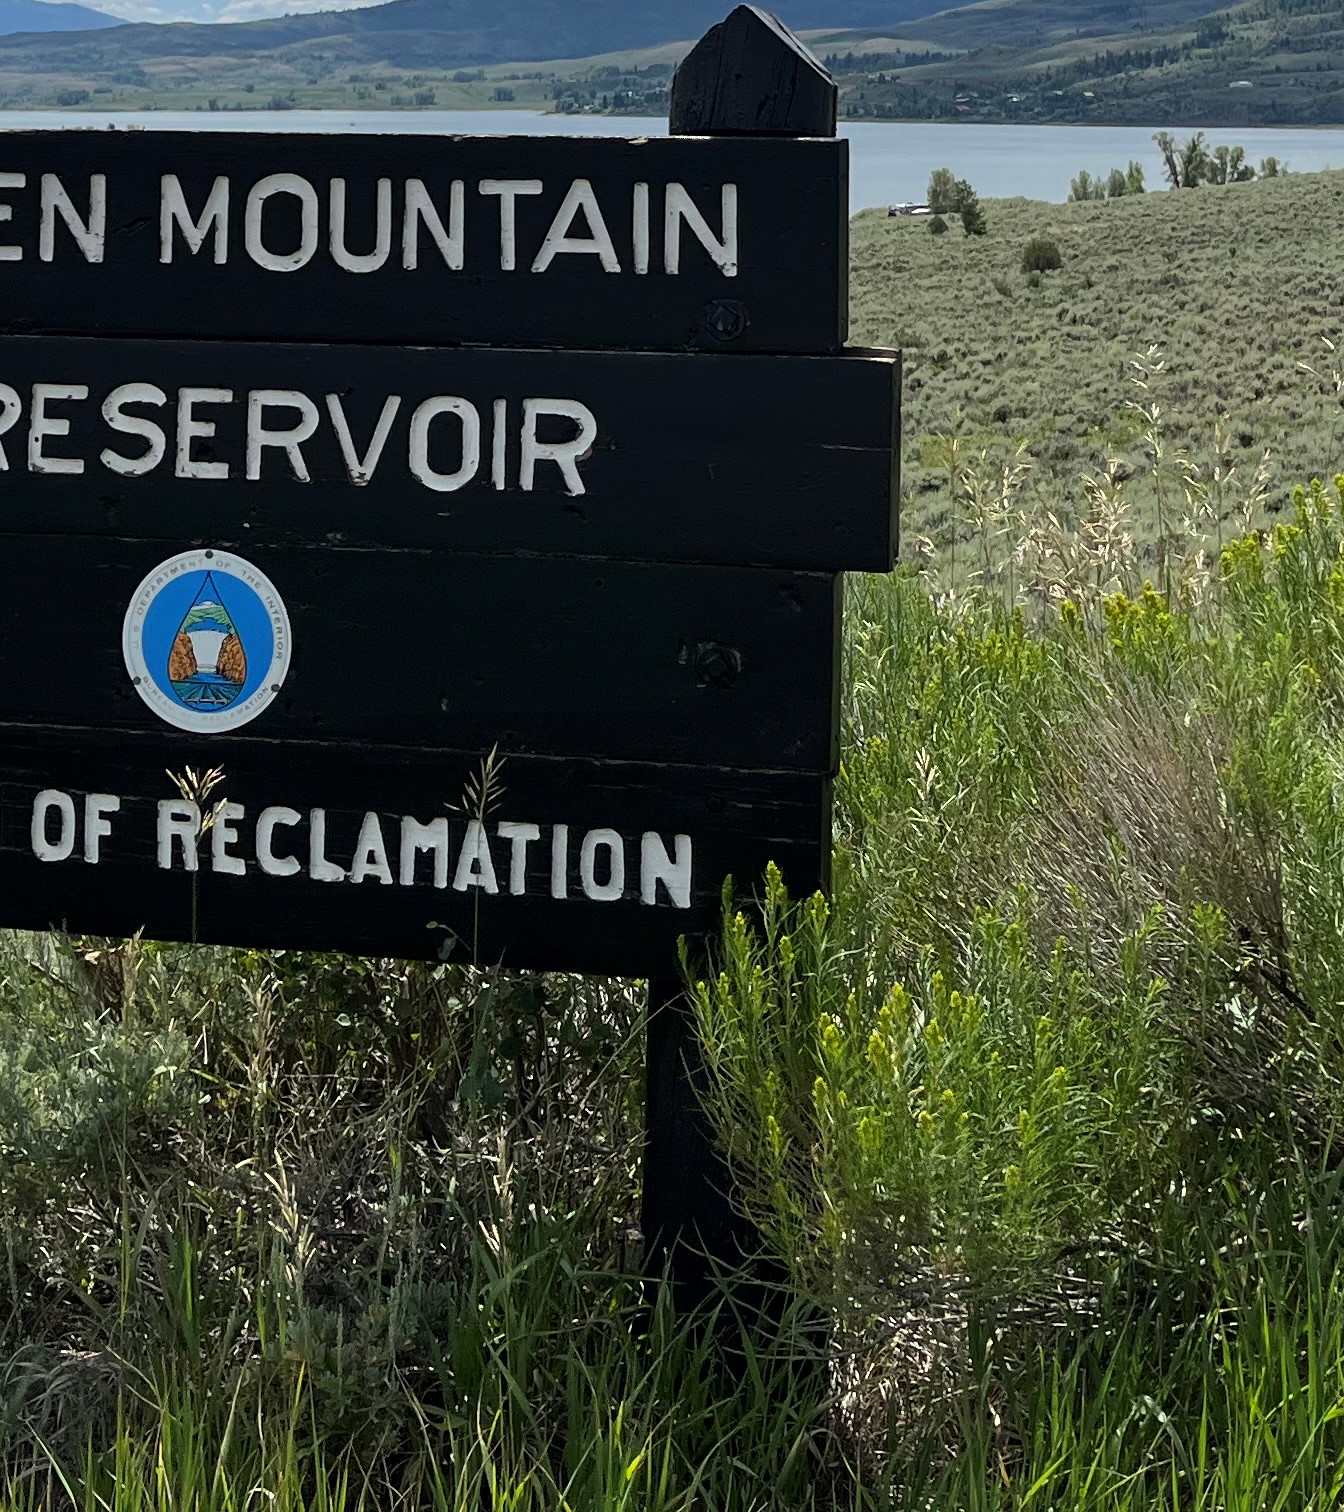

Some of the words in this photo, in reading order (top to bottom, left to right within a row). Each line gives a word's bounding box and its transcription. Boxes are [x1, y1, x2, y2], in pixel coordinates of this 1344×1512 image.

[159, 173, 738, 277] MOUNTAIN
[136, 558, 204, 616] DEPARTMENT
[215, 560, 232, 569] OF
[241, 569, 262, 590] THE
[264, 595, 285, 661] INTERIOR
[31, 789, 121, 864] OF
[157, 797, 693, 910] RECLAMATION
